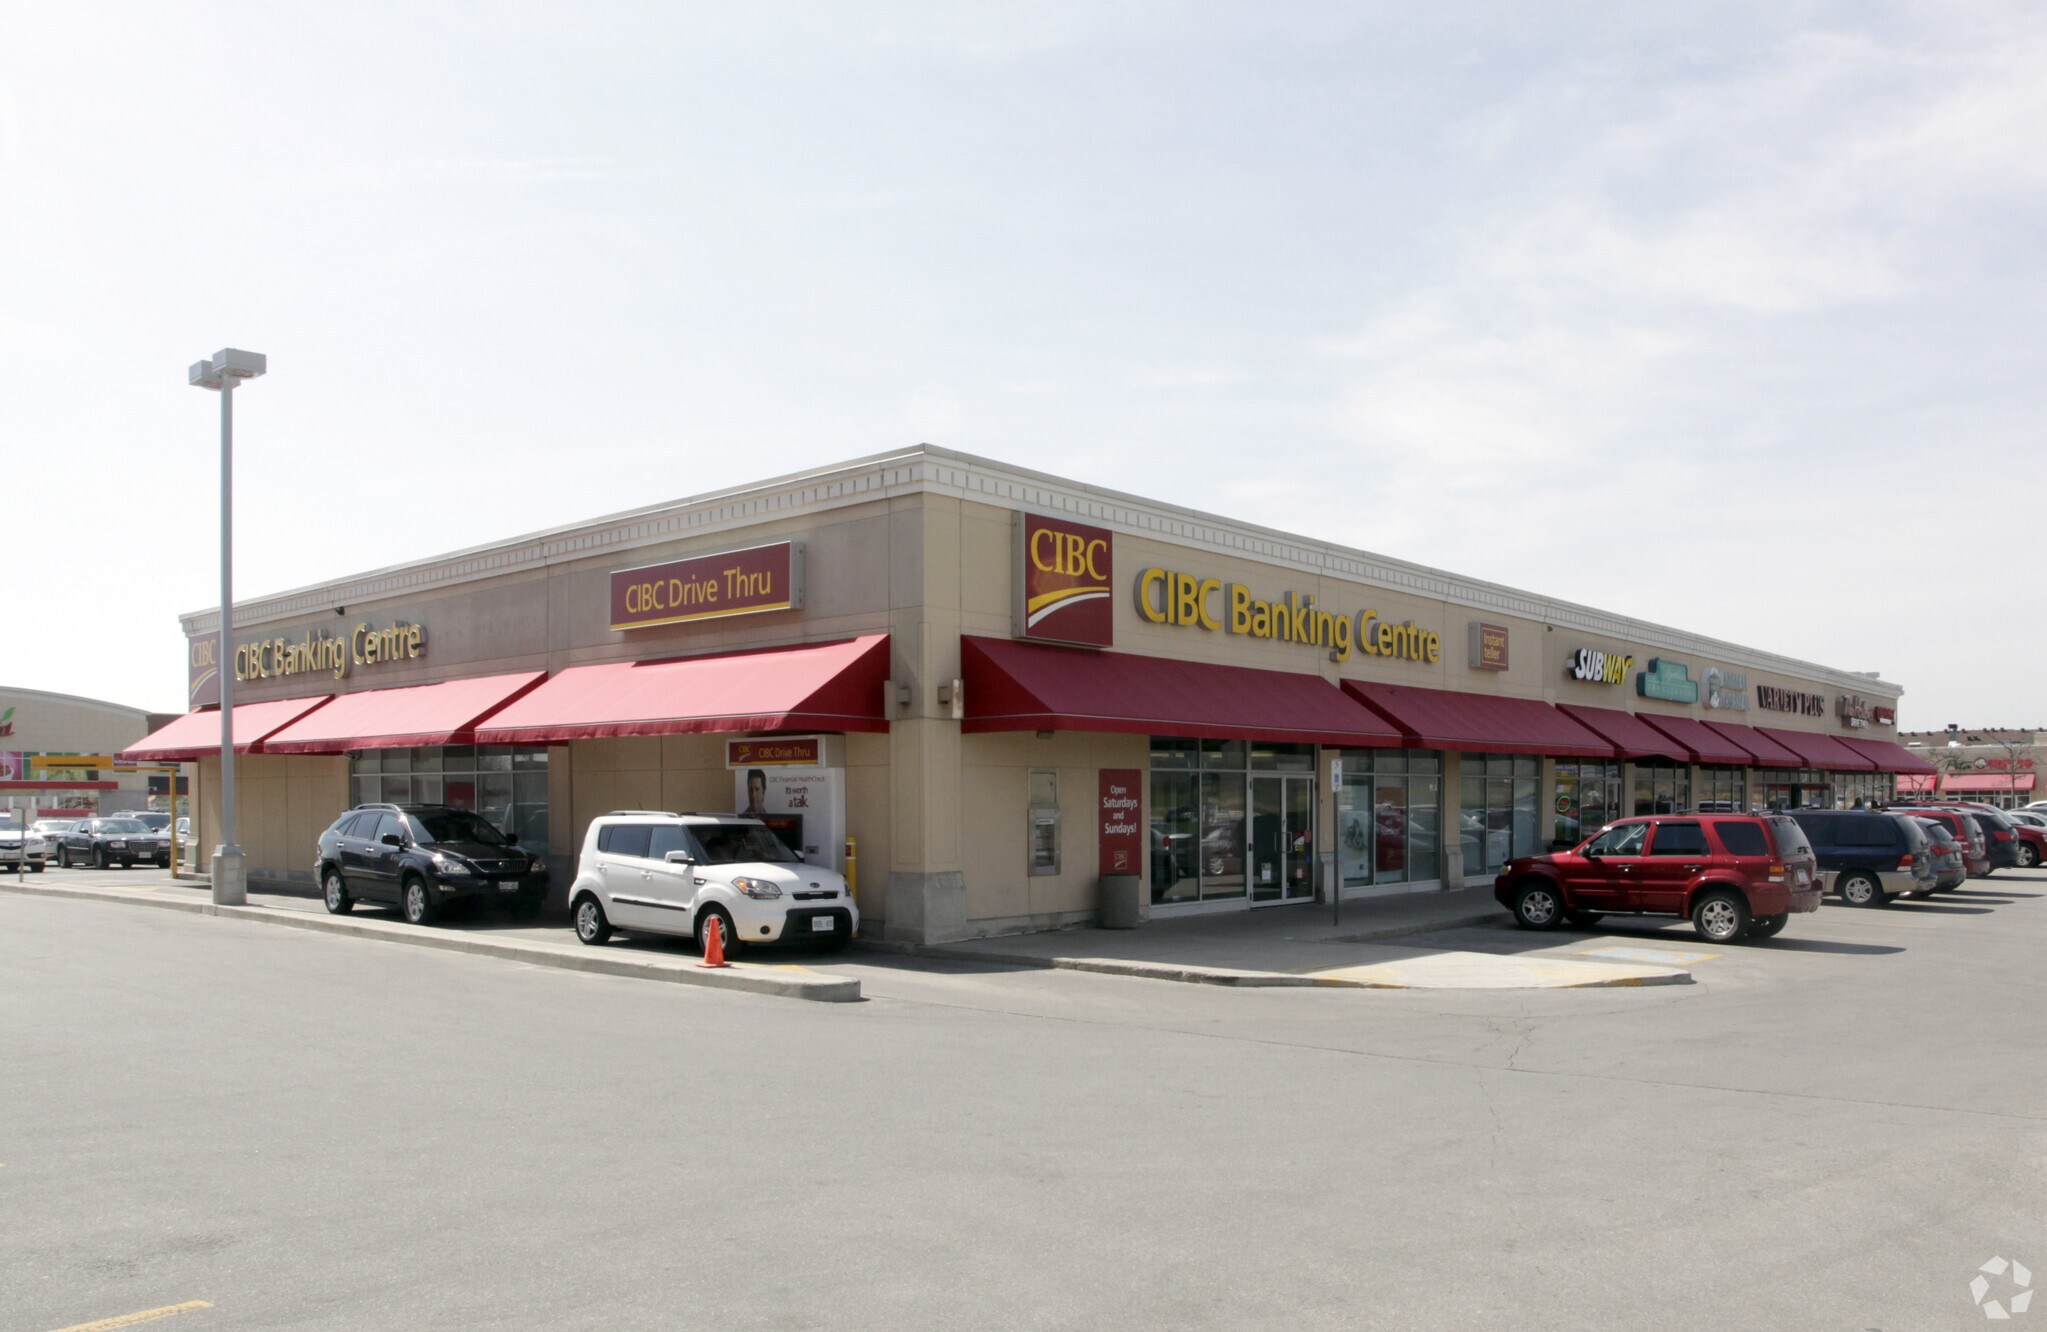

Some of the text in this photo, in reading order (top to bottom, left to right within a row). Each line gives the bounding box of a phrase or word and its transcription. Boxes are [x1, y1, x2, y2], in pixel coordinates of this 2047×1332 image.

[1030, 528, 1107, 581] CIBC
[625, 566, 772, 614] CIBC Drive Thru
[1138, 567, 1440, 664] CIBC Banking Centre
[191, 639, 217, 667] CIBC
[235, 622, 423, 681] CIBC Banking Centre
[1574, 648, 1633, 685] SUBWAY
[1757, 685, 1800, 713] VARIETY
[1801, 693, 1825, 716] PLUS
[759, 746, 811, 758] CIBC Drive Thru
[788, 799, 793, 808] a
[1103, 797, 1138, 811] Saturdays
[1110, 785, 1126, 795] Open
[1104, 822, 1137, 836] Sundays!
[1113, 811, 1125, 820] and
